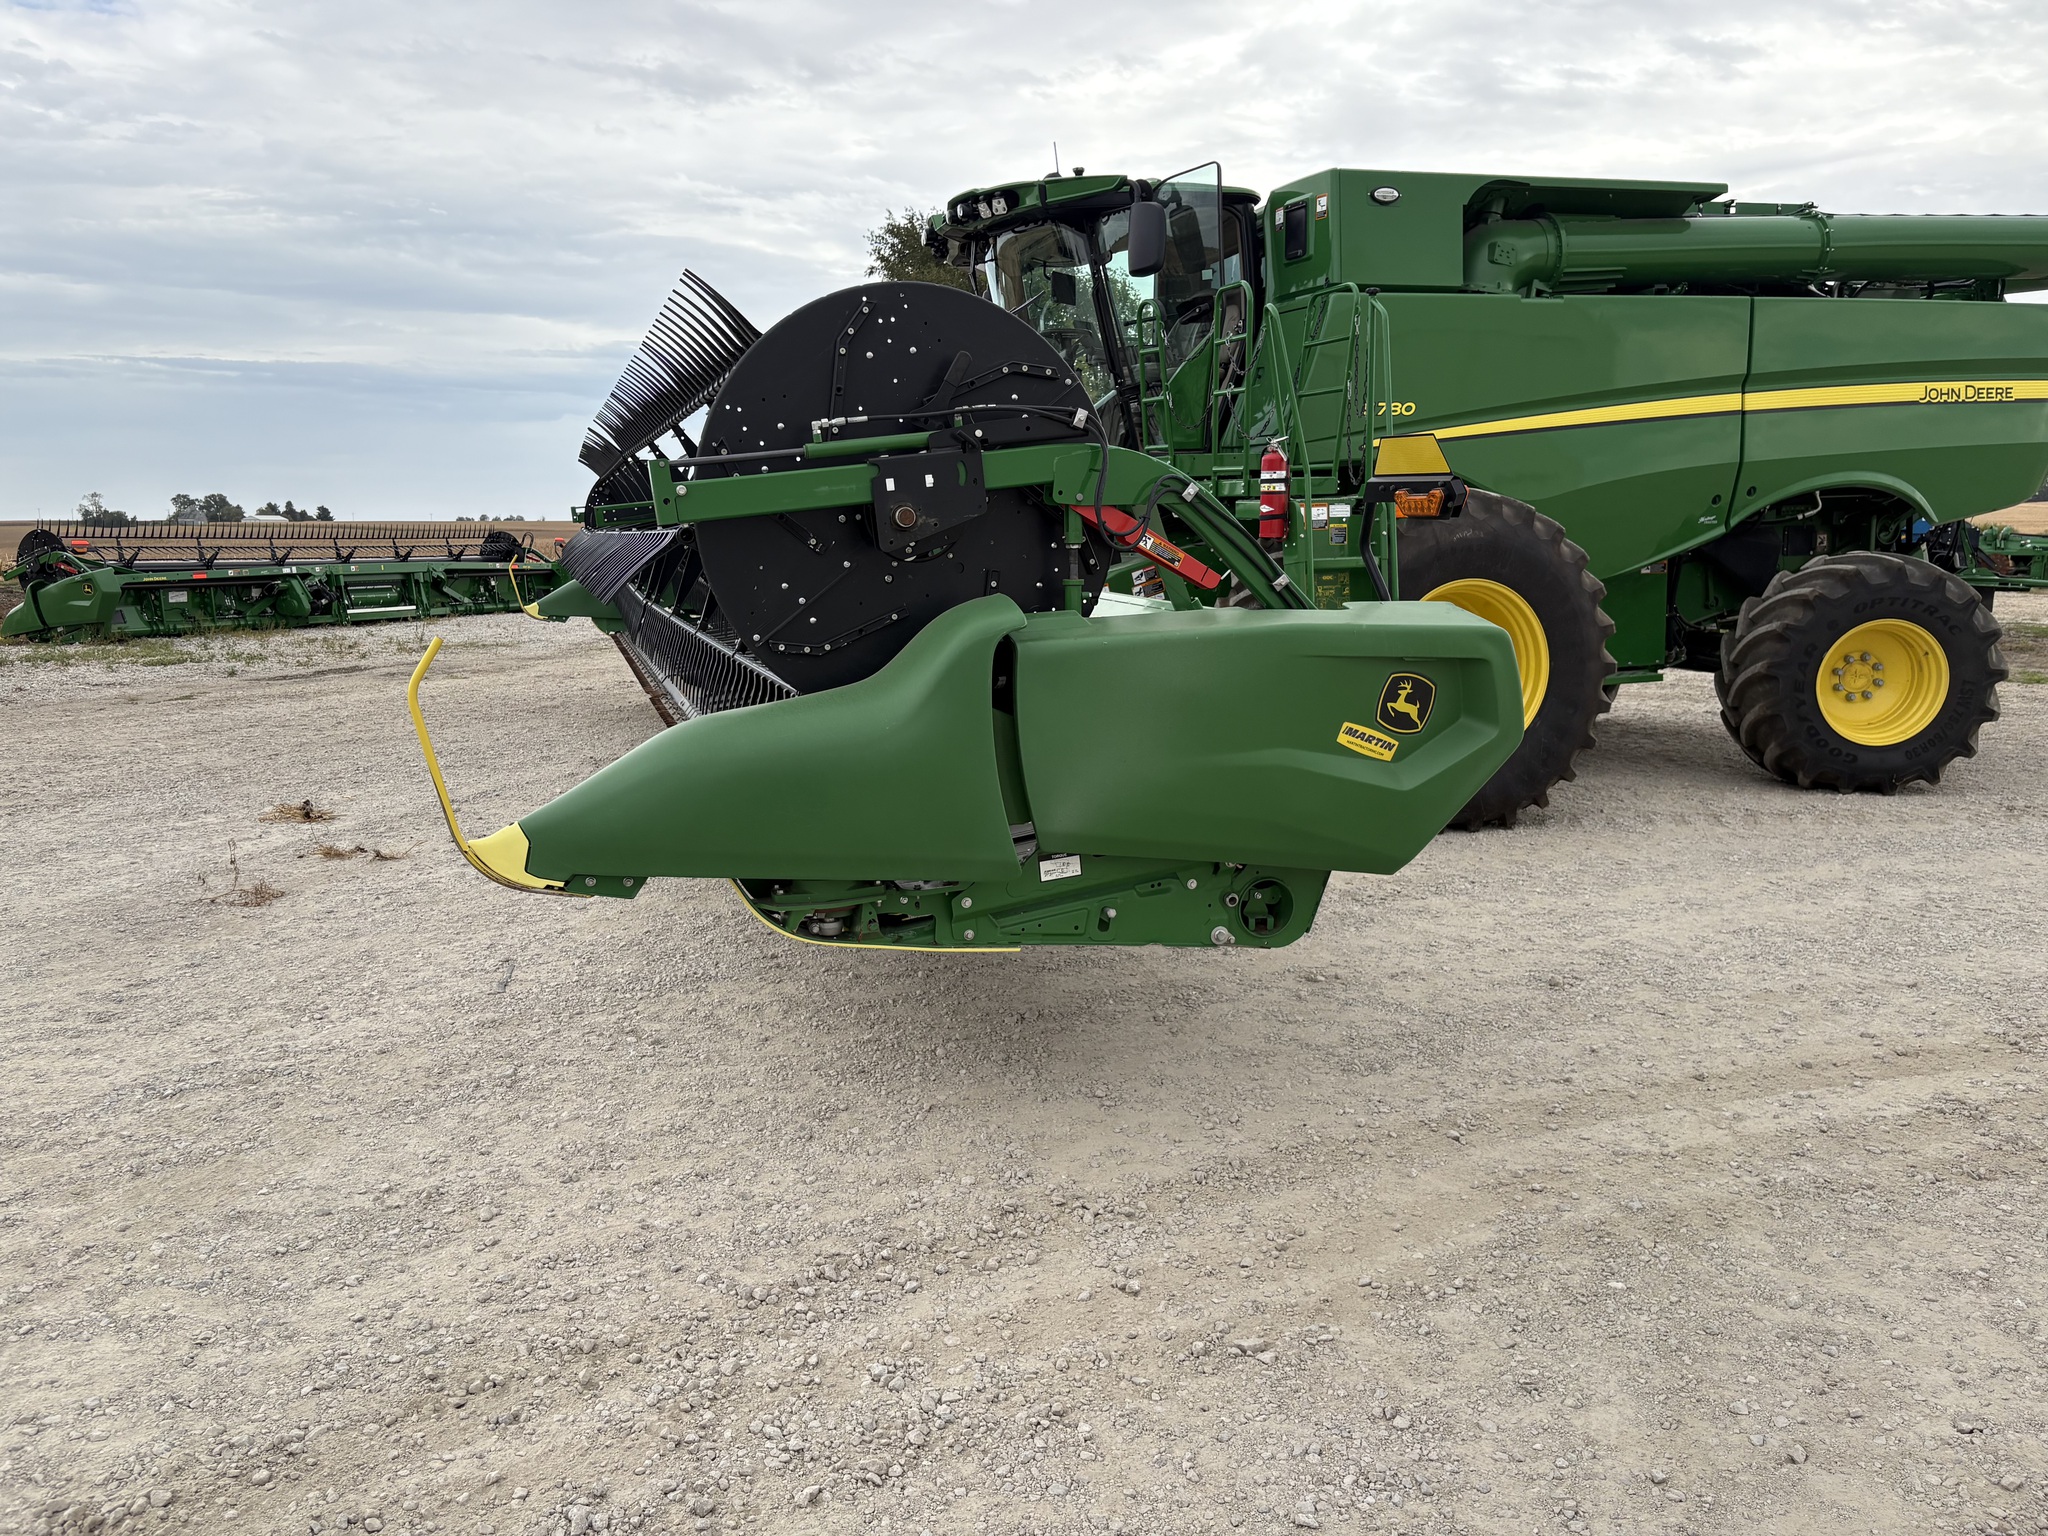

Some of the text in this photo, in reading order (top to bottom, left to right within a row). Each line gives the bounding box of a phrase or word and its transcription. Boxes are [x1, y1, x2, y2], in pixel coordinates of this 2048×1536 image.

[1919, 384, 2014, 402] JOHN DEERE
[1853, 596, 1962, 636] OPTITRAC
[1342, 726, 1396, 751] MARTIN
